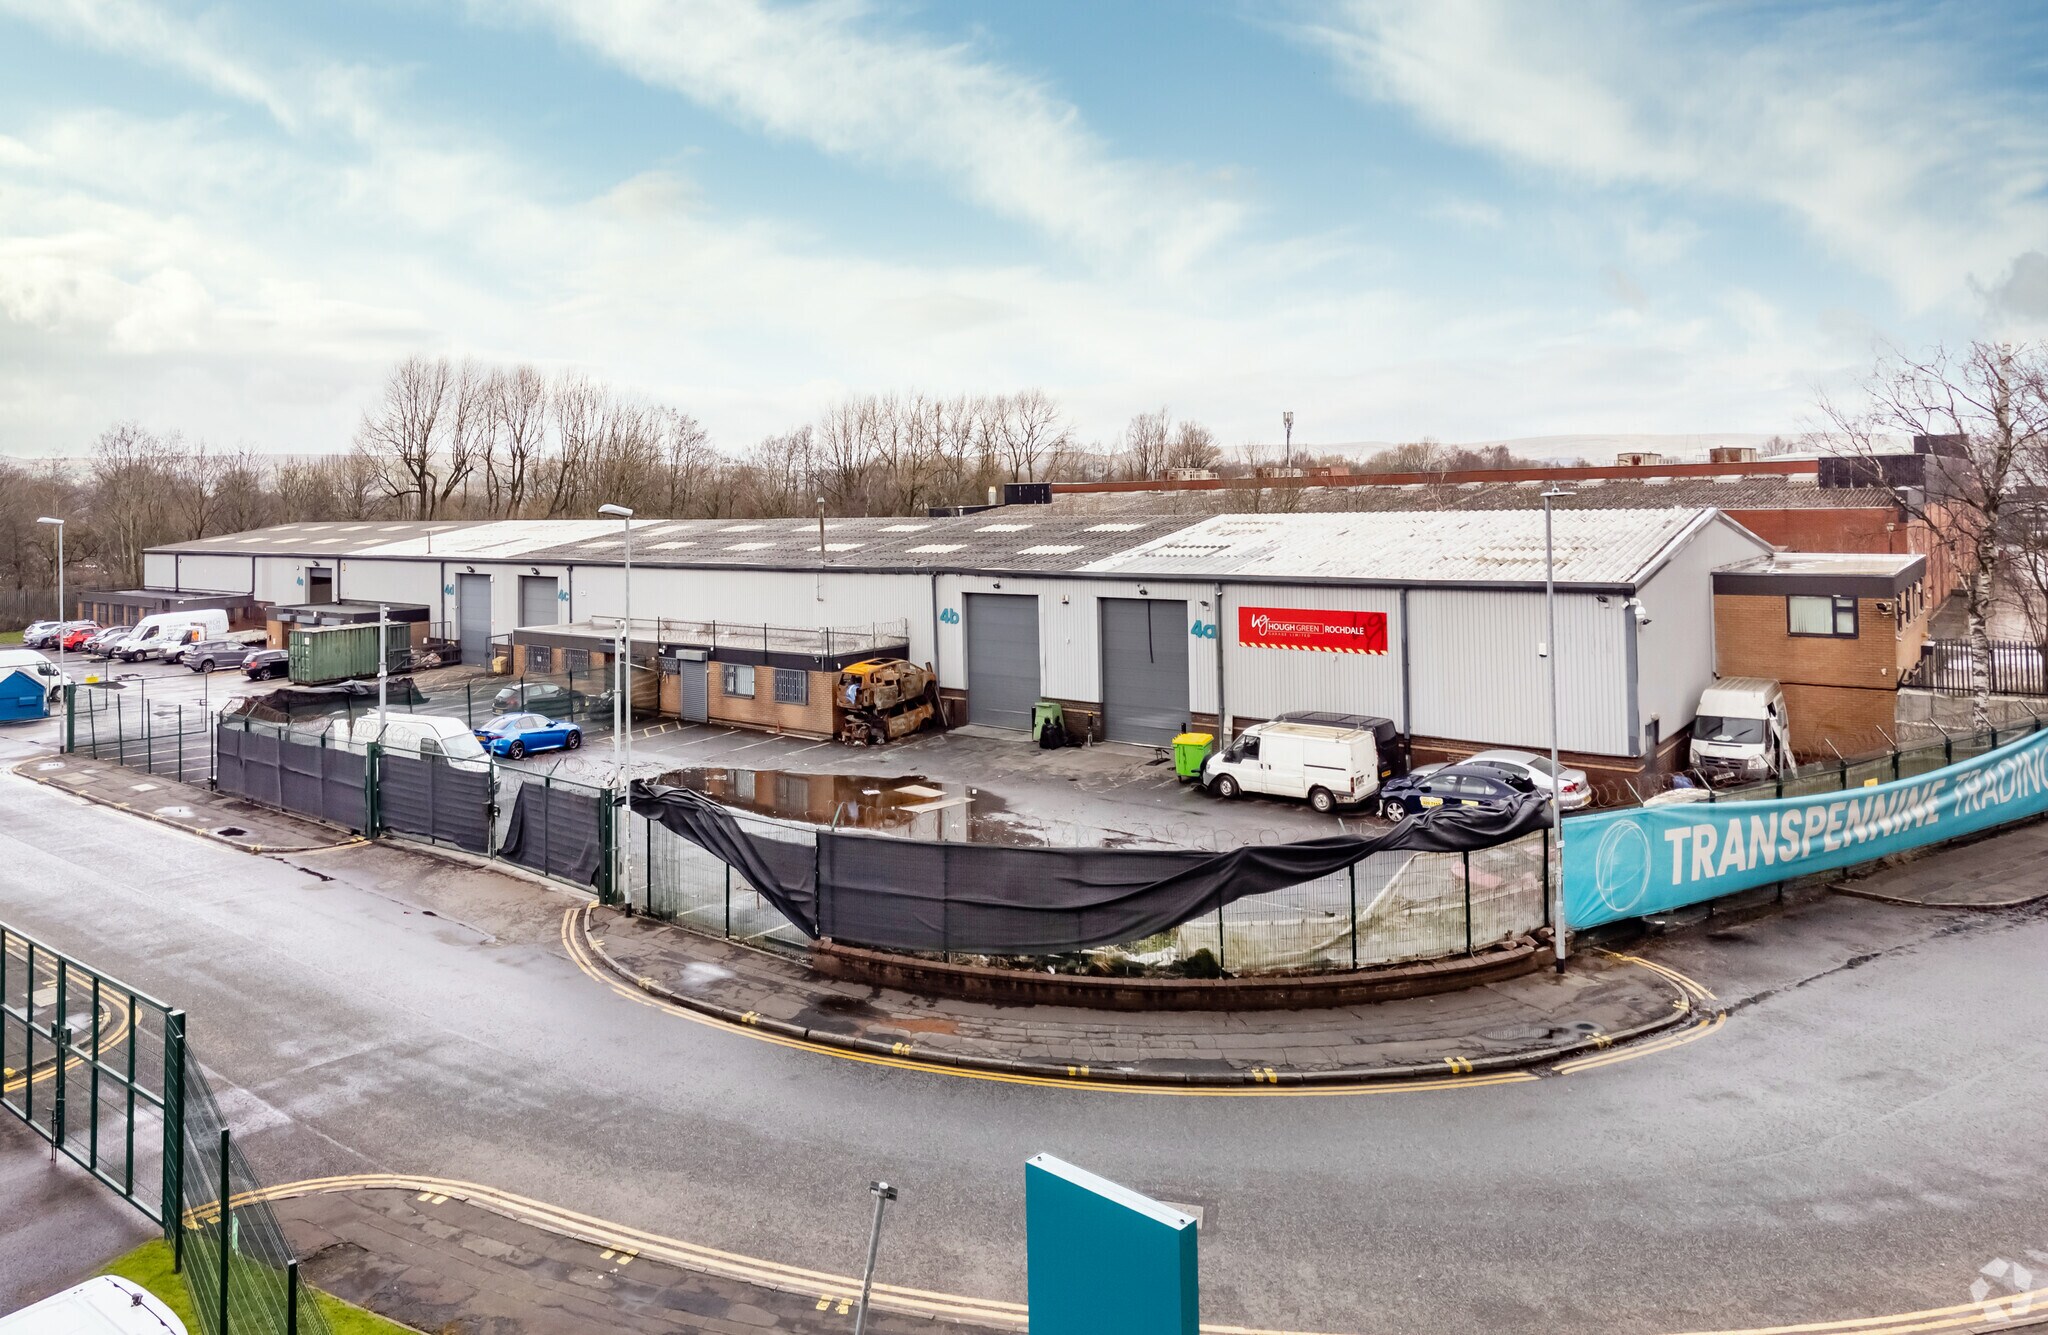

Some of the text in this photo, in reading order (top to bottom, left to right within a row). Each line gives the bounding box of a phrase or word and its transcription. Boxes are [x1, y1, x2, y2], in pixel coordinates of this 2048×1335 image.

[444, 584, 454, 595] 4d
[558, 589, 569, 601] 4c
[940, 607, 960, 625] 4b
[1190, 619, 1217, 639] 4a
[1268, 622, 1365, 636] HOUGH GREEN ROCHDALE
[1664, 779, 1947, 885] TRANSPENNINE
